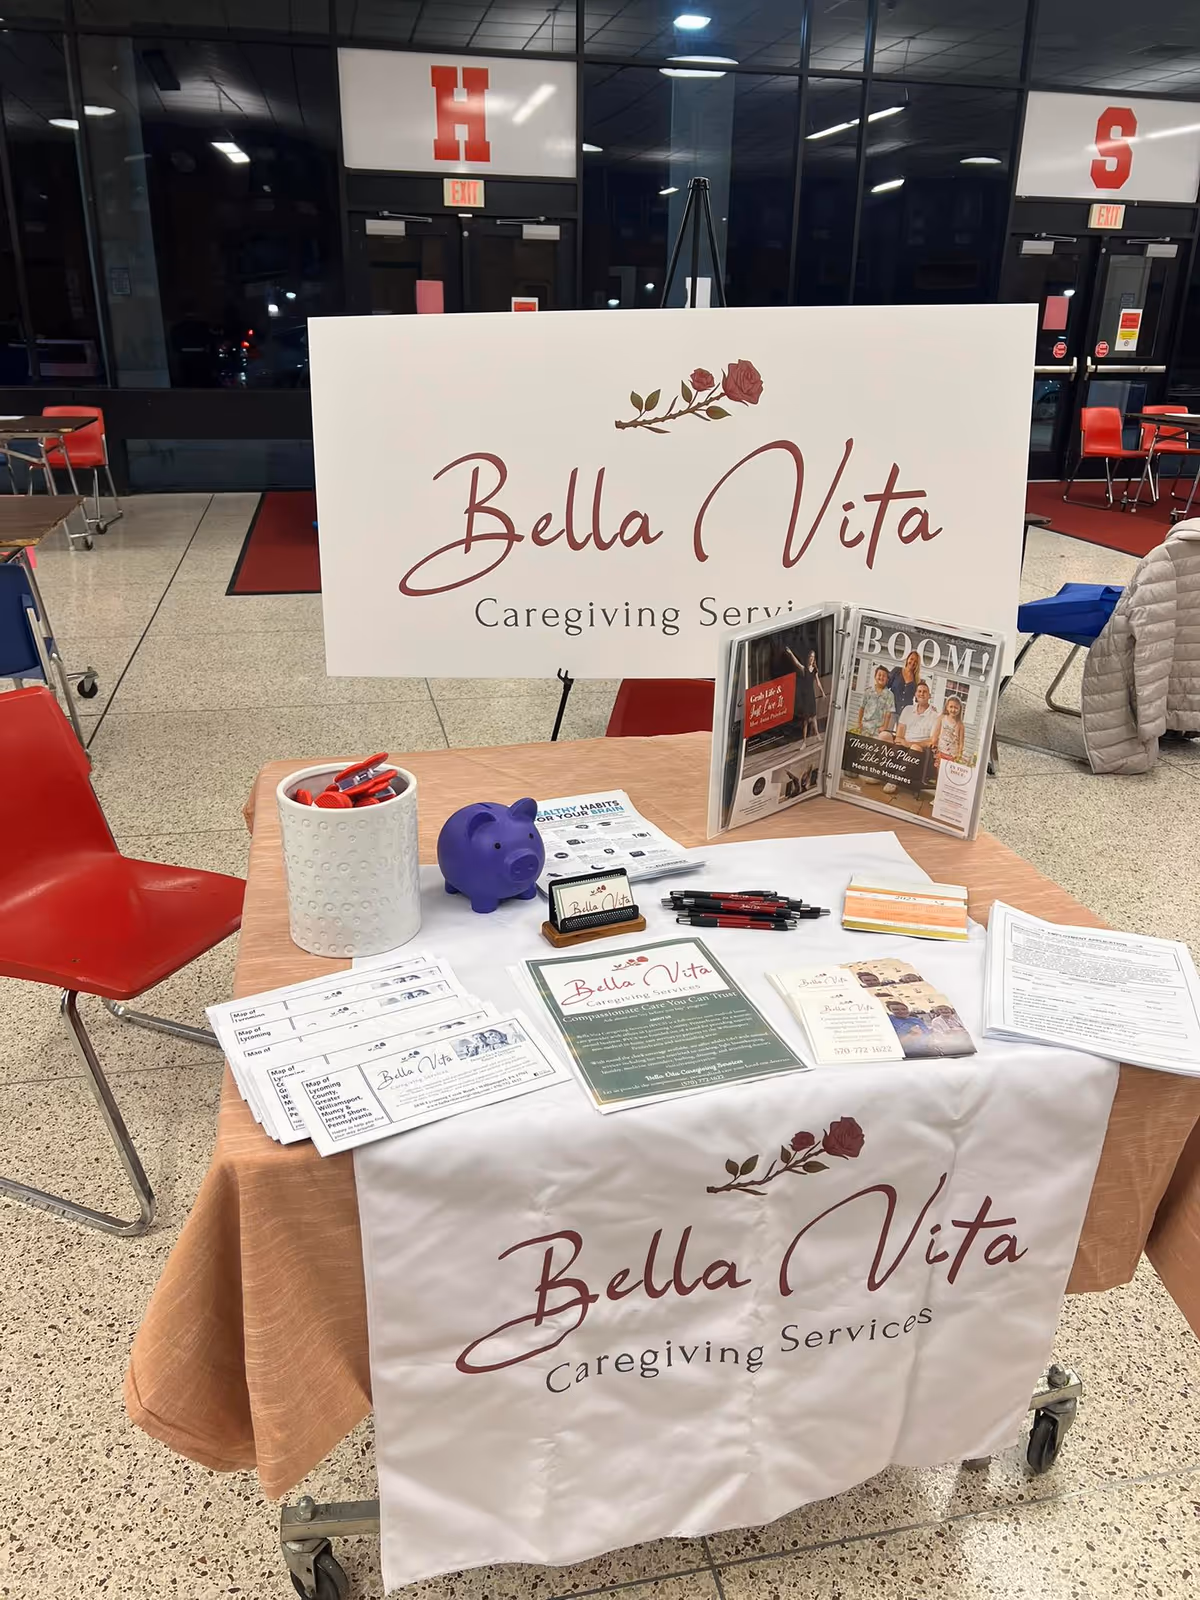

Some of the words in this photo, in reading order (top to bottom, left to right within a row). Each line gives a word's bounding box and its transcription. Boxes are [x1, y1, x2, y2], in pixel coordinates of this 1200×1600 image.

[430, 65, 490, 162] H
[1090, 106, 1138, 189] S
[450, 180, 479, 206] EXIT
[1096, 205, 1122, 227] EXIT
[398, 451, 664, 597] Bella
[693, 437, 943, 570] Vita
[474, 597, 680, 636] Caregiving
[861, 624, 990, 682] BOOM!
[765, 687, 776, 698] Life
[776, 685, 782, 694] &
[849, 737, 879, 753] There's
[880, 745, 895, 758] No
[897, 749, 921, 766] Place
[860, 751, 879, 765] Like
[880, 756, 907, 773] Home
[852, 762, 868, 772] Meet
[869, 765, 881, 775] the
[881, 770, 911, 784] Mussares
[536, 805, 577, 818] EALTHY
[580, 800, 620, 811] HABITS
[556, 811, 590, 820] YOUR
[590, 806, 625, 815] BRAIN
[568, 901, 599, 917] Bella
[601, 892, 631, 911] Vita
[561, 977, 636, 1006] Bella
[643, 961, 713, 986] Vita
[586, 991, 651, 1008] Caregiving
[652, 983, 701, 996] Services
[233, 1011, 249, 1020] Map
[562, 1007, 640, 1024] Compassionate
[641, 1002, 665, 1012] Care
[665, 998, 687, 1008] You
[688, 993, 710, 1003] Can
[711, 990, 738, 1000] Trust
[238, 1029, 253, 1038] Map
[240, 1031, 271, 1043] Lycoming
[271, 1067, 286, 1077] Map
[305, 1079, 321, 1089] Map
[322, 1076, 330, 1084] of
[377, 1067, 414, 1091] Bella
[417, 1053, 453, 1073] Vita
[308, 1081, 341, 1095] Lycoming
[315, 1095, 341, 1106] Greater
[317, 1095, 363, 1112] Williamsport,
[321, 1107, 344, 1117] Muncy
[325, 1113, 346, 1123] Jersey
[328, 1111, 372, 1129] Pennsylvania
[455, 1225, 752, 1374] Bella
[779, 1172, 1029, 1296] Vita
[546, 1339, 765, 1393] Caregiving
[780, 1307, 932, 1352] Services
